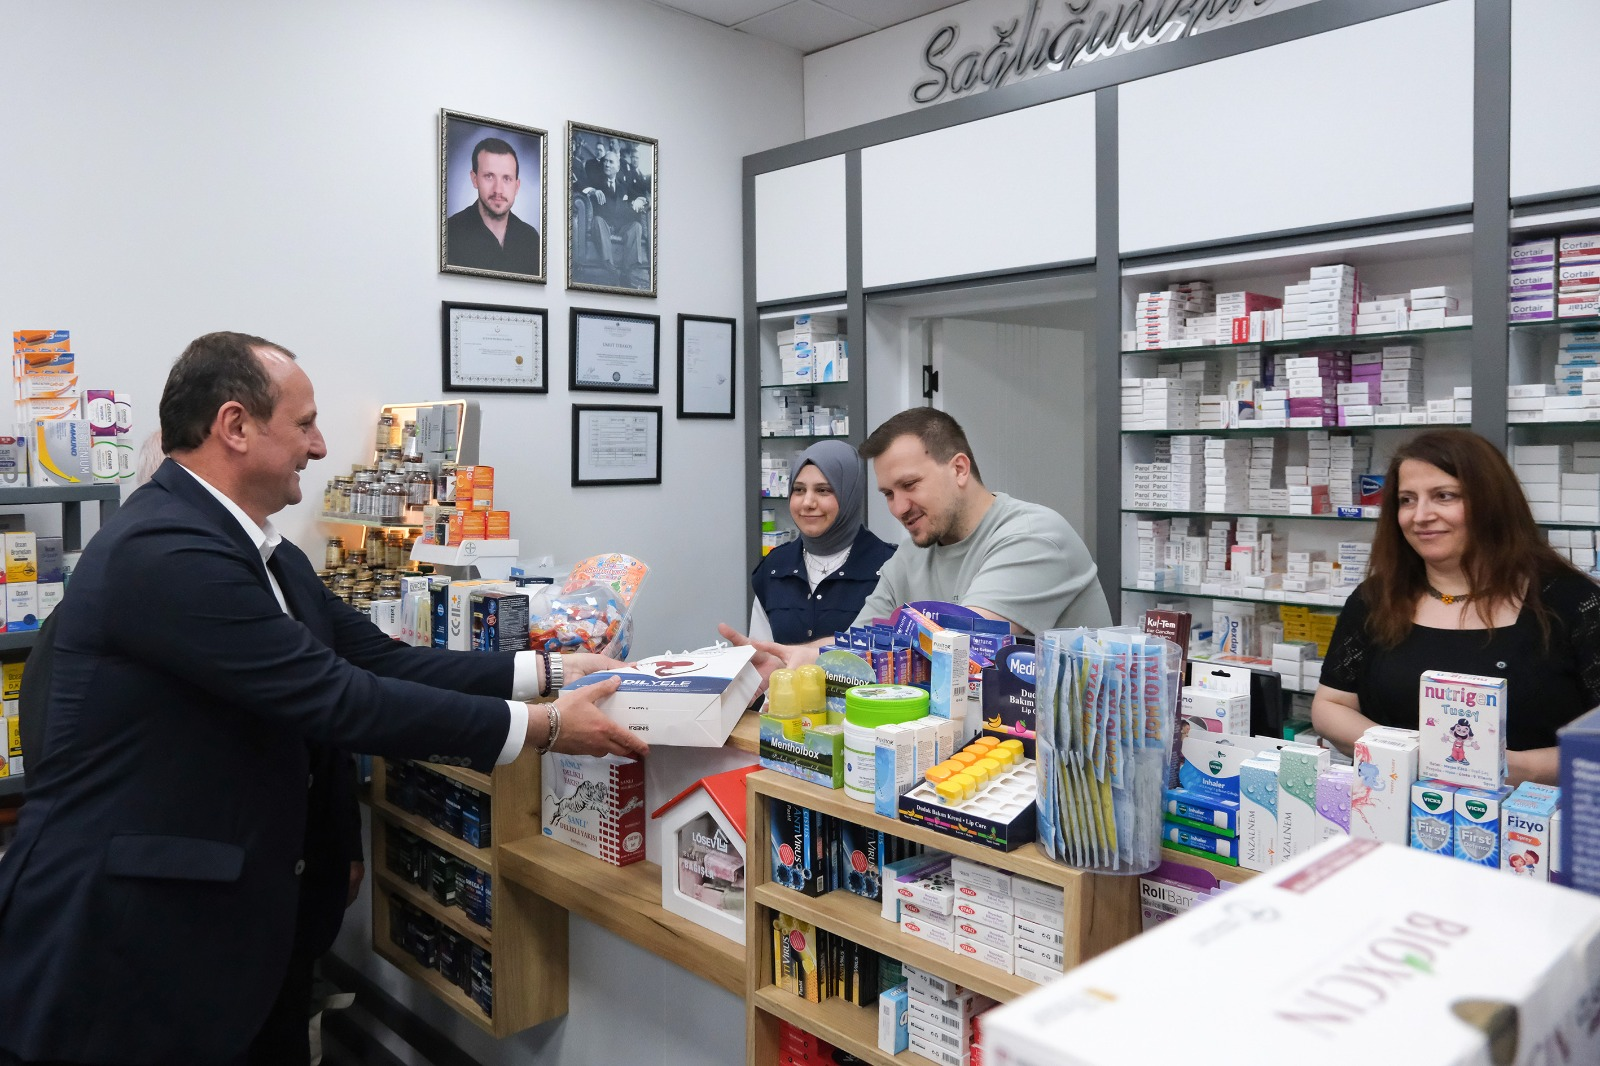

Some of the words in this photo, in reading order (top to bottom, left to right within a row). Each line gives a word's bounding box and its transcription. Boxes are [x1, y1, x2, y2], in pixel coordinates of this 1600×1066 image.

[1562, 241, 1595, 250] Cortair
[1513, 248, 1544, 258] Cortair
[1562, 270, 1595, 279] Cortair
[1513, 276, 1543, 286] Cortair
[1513, 304, 1543, 313] Cortair
[1568, 302, 1600, 312] Cortair
[1229, 621, 1239, 655] Dexday
[1425, 686, 1498, 707] nutrigen
[1441, 704, 1480, 722] Tussy
[770, 736, 820, 760] Mentholbox
[1202, 777, 1226, 789] Inhaler
[1423, 796, 1443, 805] VICKS
[1467, 804, 1486, 813] VICKS
[974, 821, 987, 830] Care
[1418, 822, 1447, 836] First
[1507, 815, 1544, 832] Fizyo
[1248, 810, 1256, 862] NAZALNEM
[1282, 811, 1293, 863] AZALNEM
[1420, 832, 1445, 842] Defence
[1461, 830, 1492, 844] First
[1464, 841, 1490, 851] Defence
[1142, 882, 1165, 901] Roll
